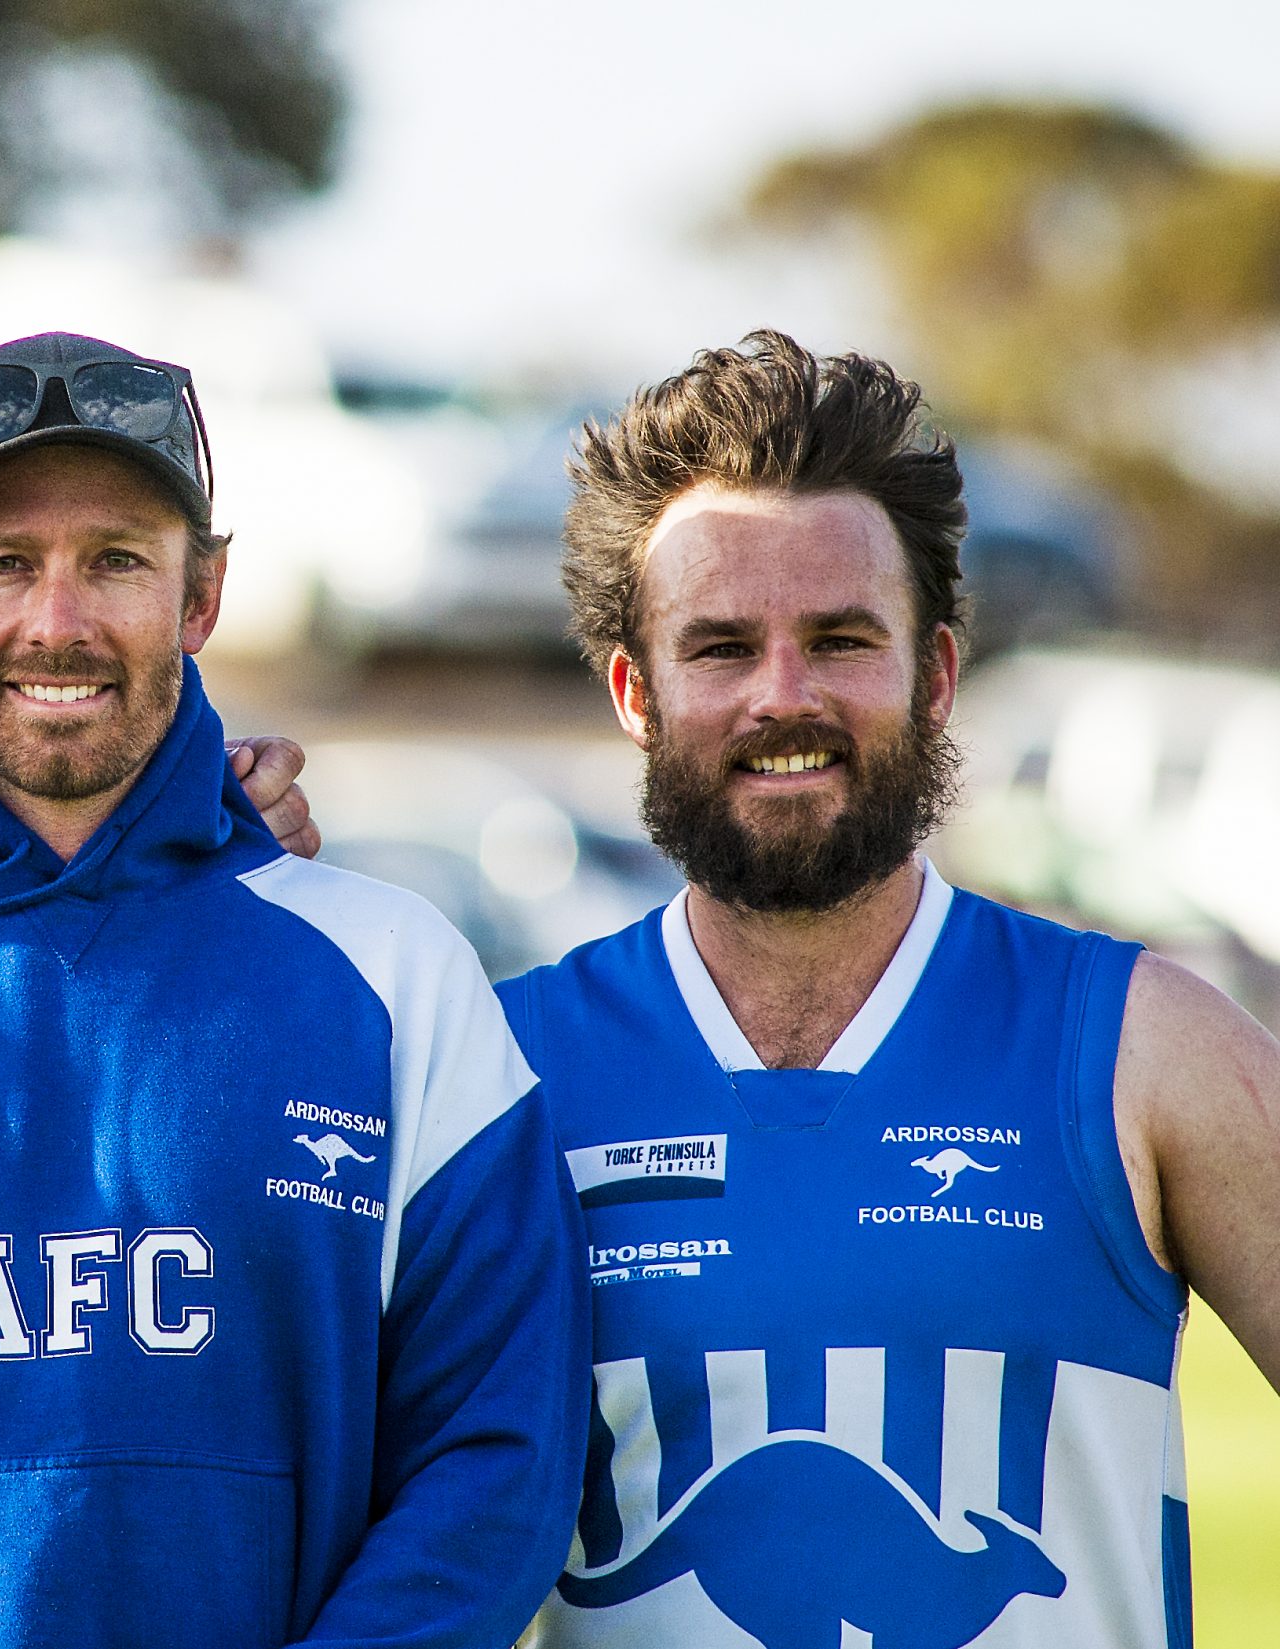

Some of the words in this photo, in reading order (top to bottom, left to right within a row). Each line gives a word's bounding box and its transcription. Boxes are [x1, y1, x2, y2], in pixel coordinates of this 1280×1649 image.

[284, 1099, 386, 1137] ARDROSSAN
[881, 1127, 1021, 1145] ARDROSSAN
[605, 1146, 644, 1167] YORKE
[648, 1141, 716, 1162] PENINSULA
[645, 1160, 716, 1174] CARPETS
[266, 1178, 346, 1210] FOOTBALL
[351, 1195, 385, 1221] CLUB
[858, 1205, 979, 1224] FOOTBALL
[984, 1208, 1044, 1231] CLUB
